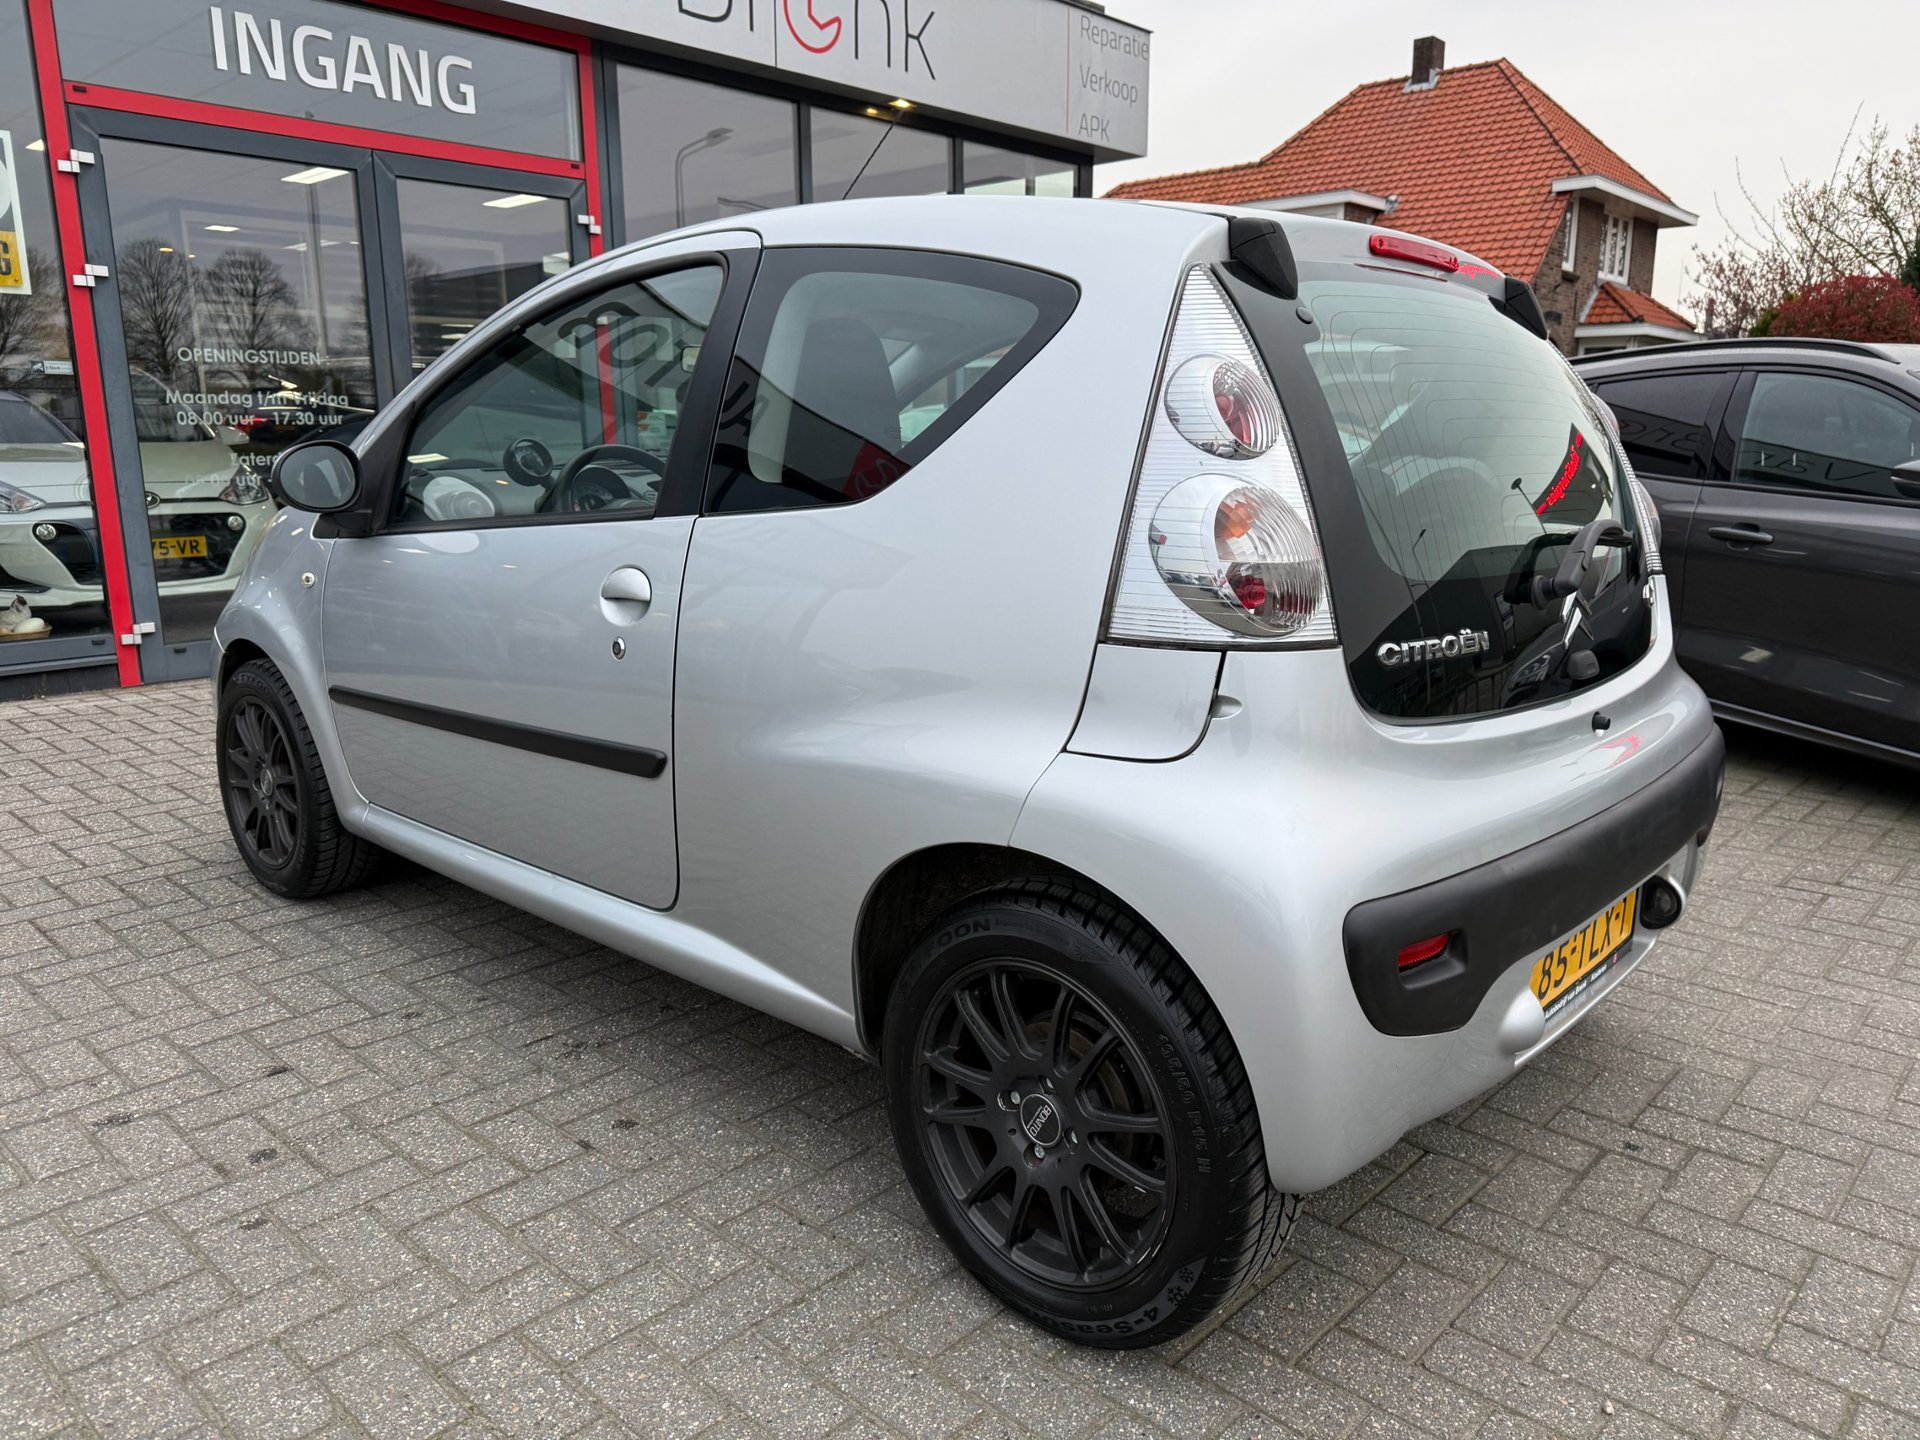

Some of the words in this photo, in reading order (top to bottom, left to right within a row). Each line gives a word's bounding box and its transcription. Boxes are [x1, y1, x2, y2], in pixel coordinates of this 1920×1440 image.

[1080, 14, 1149, 61] Reparatie
[209, 6, 477, 115] INGANG
[1080, 64, 1138, 108] Verkoop
[1079, 112, 1110, 143] APK
[177, 347, 321, 366] OPENINGSTIJDEN
[165, 390, 253, 408] Maandag
[176, 411, 224, 426] 08.00
[228, 414, 255, 426] uur
[273, 412, 314, 426] 17.30
[318, 414, 344, 425] uur
[229, 451, 279, 467] Zater
[1376, 628, 1490, 666] CITROËN
